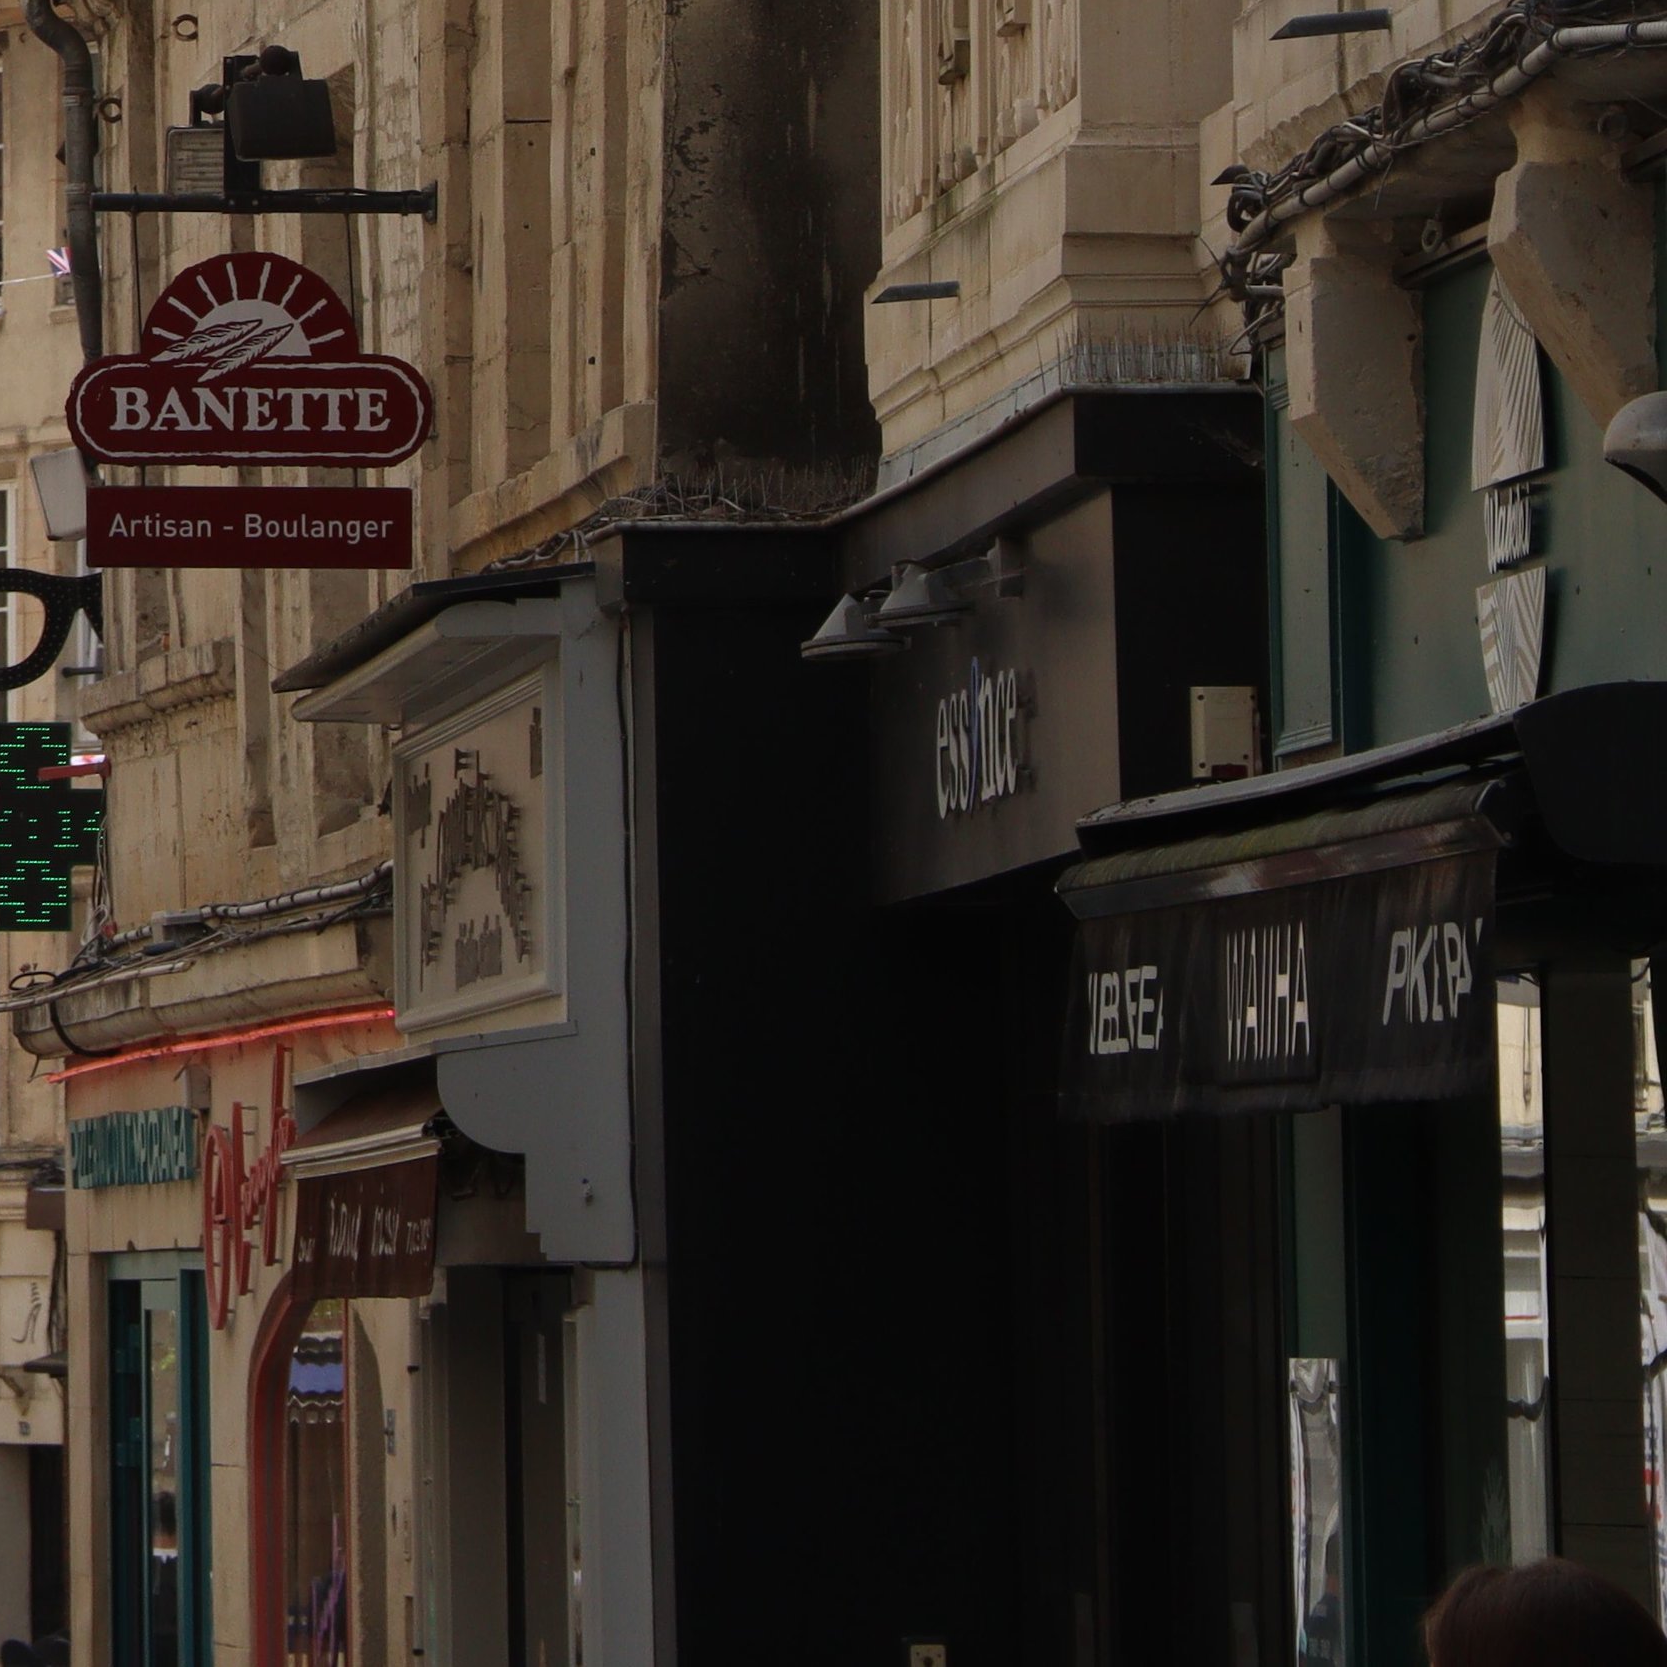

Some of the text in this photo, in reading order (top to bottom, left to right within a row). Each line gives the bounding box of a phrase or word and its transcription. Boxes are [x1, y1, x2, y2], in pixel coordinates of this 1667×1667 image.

[109, 386, 392, 432] BANETTE
[108, 512, 212, 539] Artisan
[244, 512, 394, 545] Boulanger
